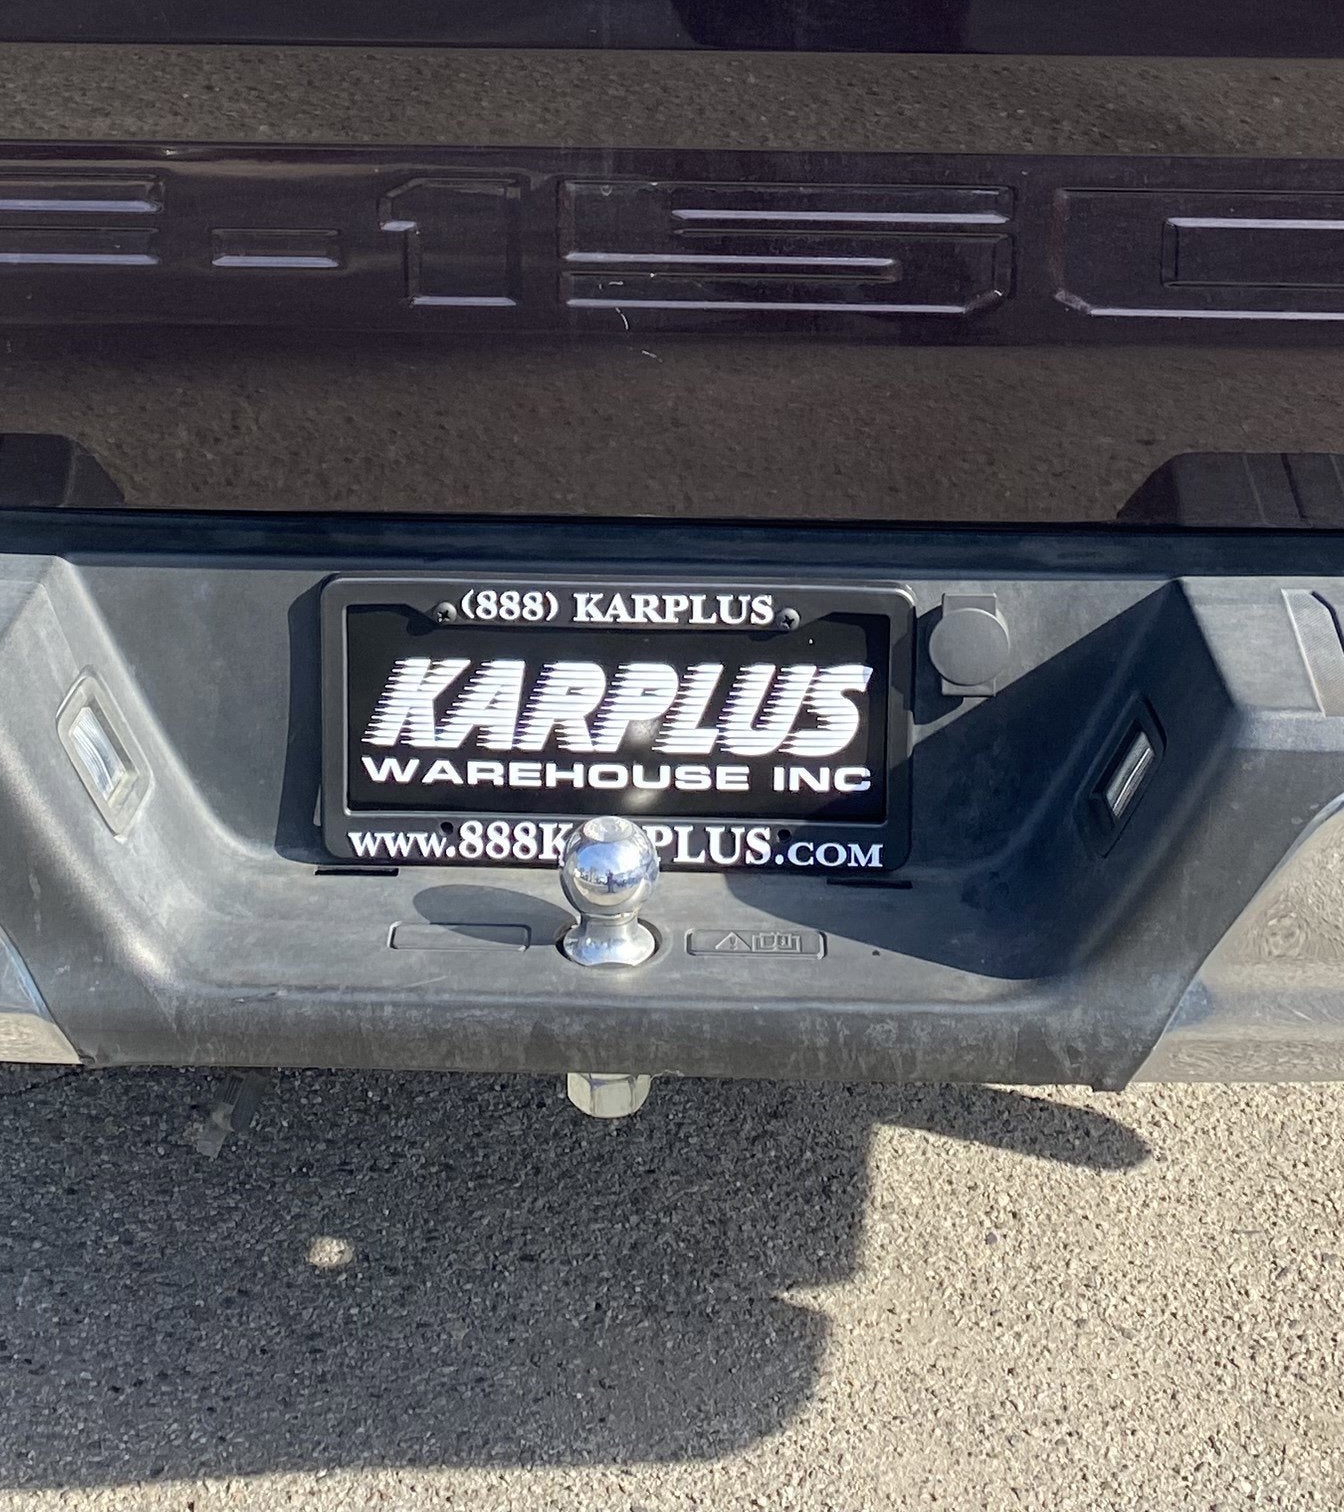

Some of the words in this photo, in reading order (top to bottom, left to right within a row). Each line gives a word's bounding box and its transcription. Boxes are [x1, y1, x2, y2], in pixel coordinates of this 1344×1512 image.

[459, 588, 559, 624] (888)
[573, 592, 775, 627] KARPLUS
[361, 657, 874, 757] KARPLUS
[361, 755, 750, 792] WAREHOUSE
[772, 765, 872, 793] INC
